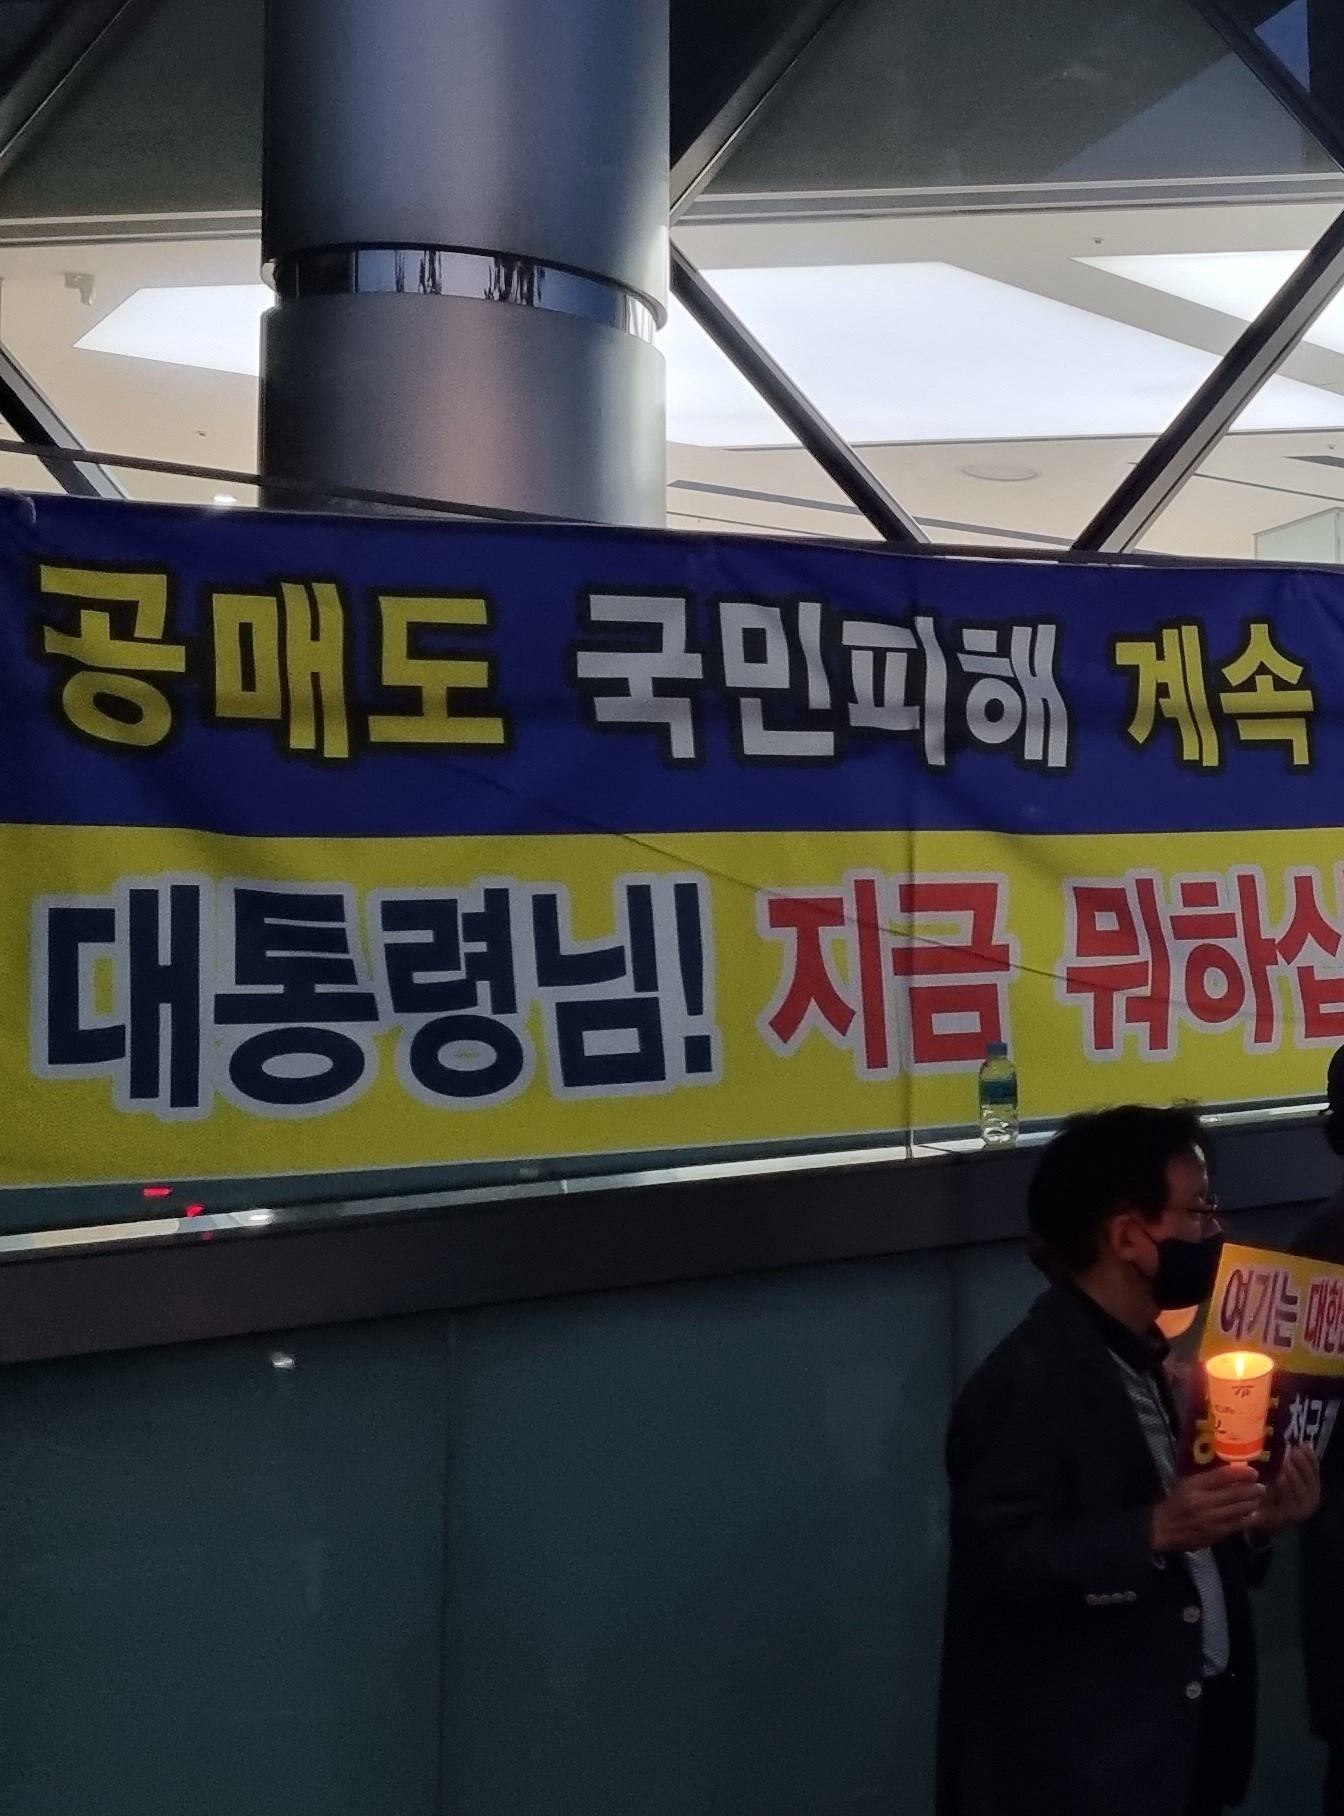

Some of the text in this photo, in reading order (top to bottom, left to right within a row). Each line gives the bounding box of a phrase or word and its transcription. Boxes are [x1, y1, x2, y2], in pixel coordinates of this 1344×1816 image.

[38, 562, 508, 760] 공매도
[576, 593, 1069, 769] 국민피해
[1115, 622, 1314, 768] 계속
[47, 880, 714, 1108] 대통령님!
[766, 876, 1012, 1072] 지금
[1220, 1267, 1298, 1348] 여기는
